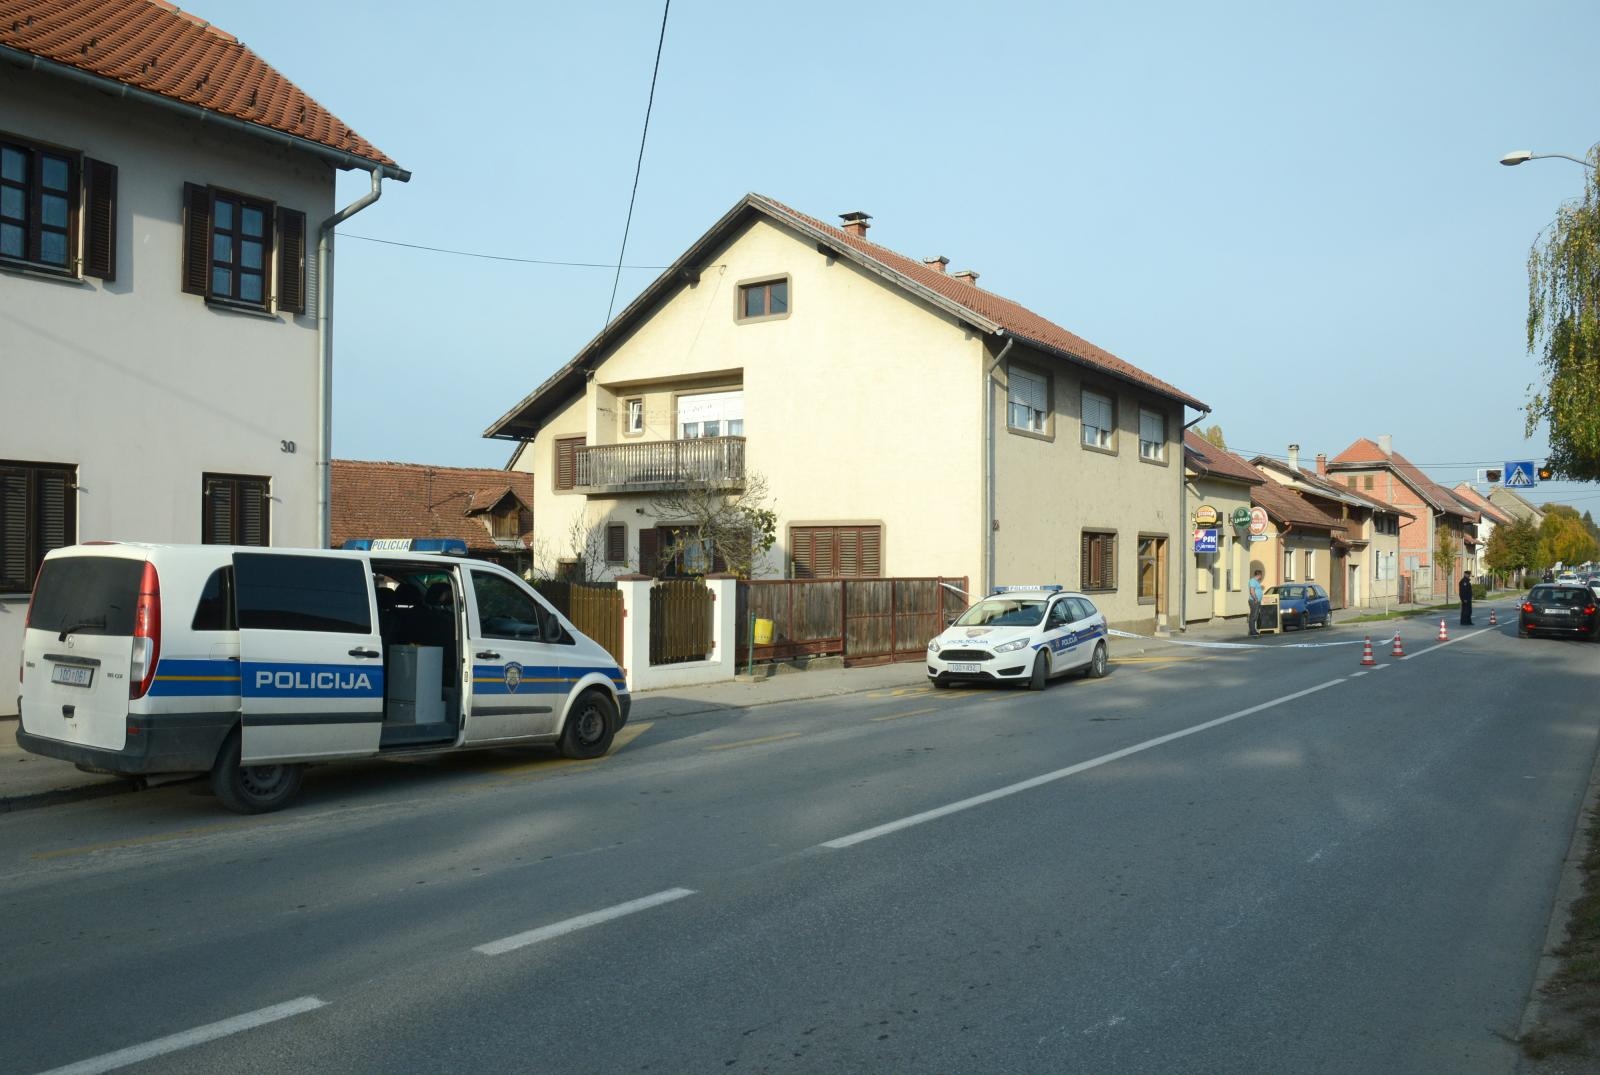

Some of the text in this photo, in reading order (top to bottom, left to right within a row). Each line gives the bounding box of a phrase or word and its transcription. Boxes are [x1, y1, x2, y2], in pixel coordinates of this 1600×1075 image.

[280, 439, 296, 454] 30
[371, 540, 410, 550] POLICIJA
[255, 671, 373, 690] POLICIJA
